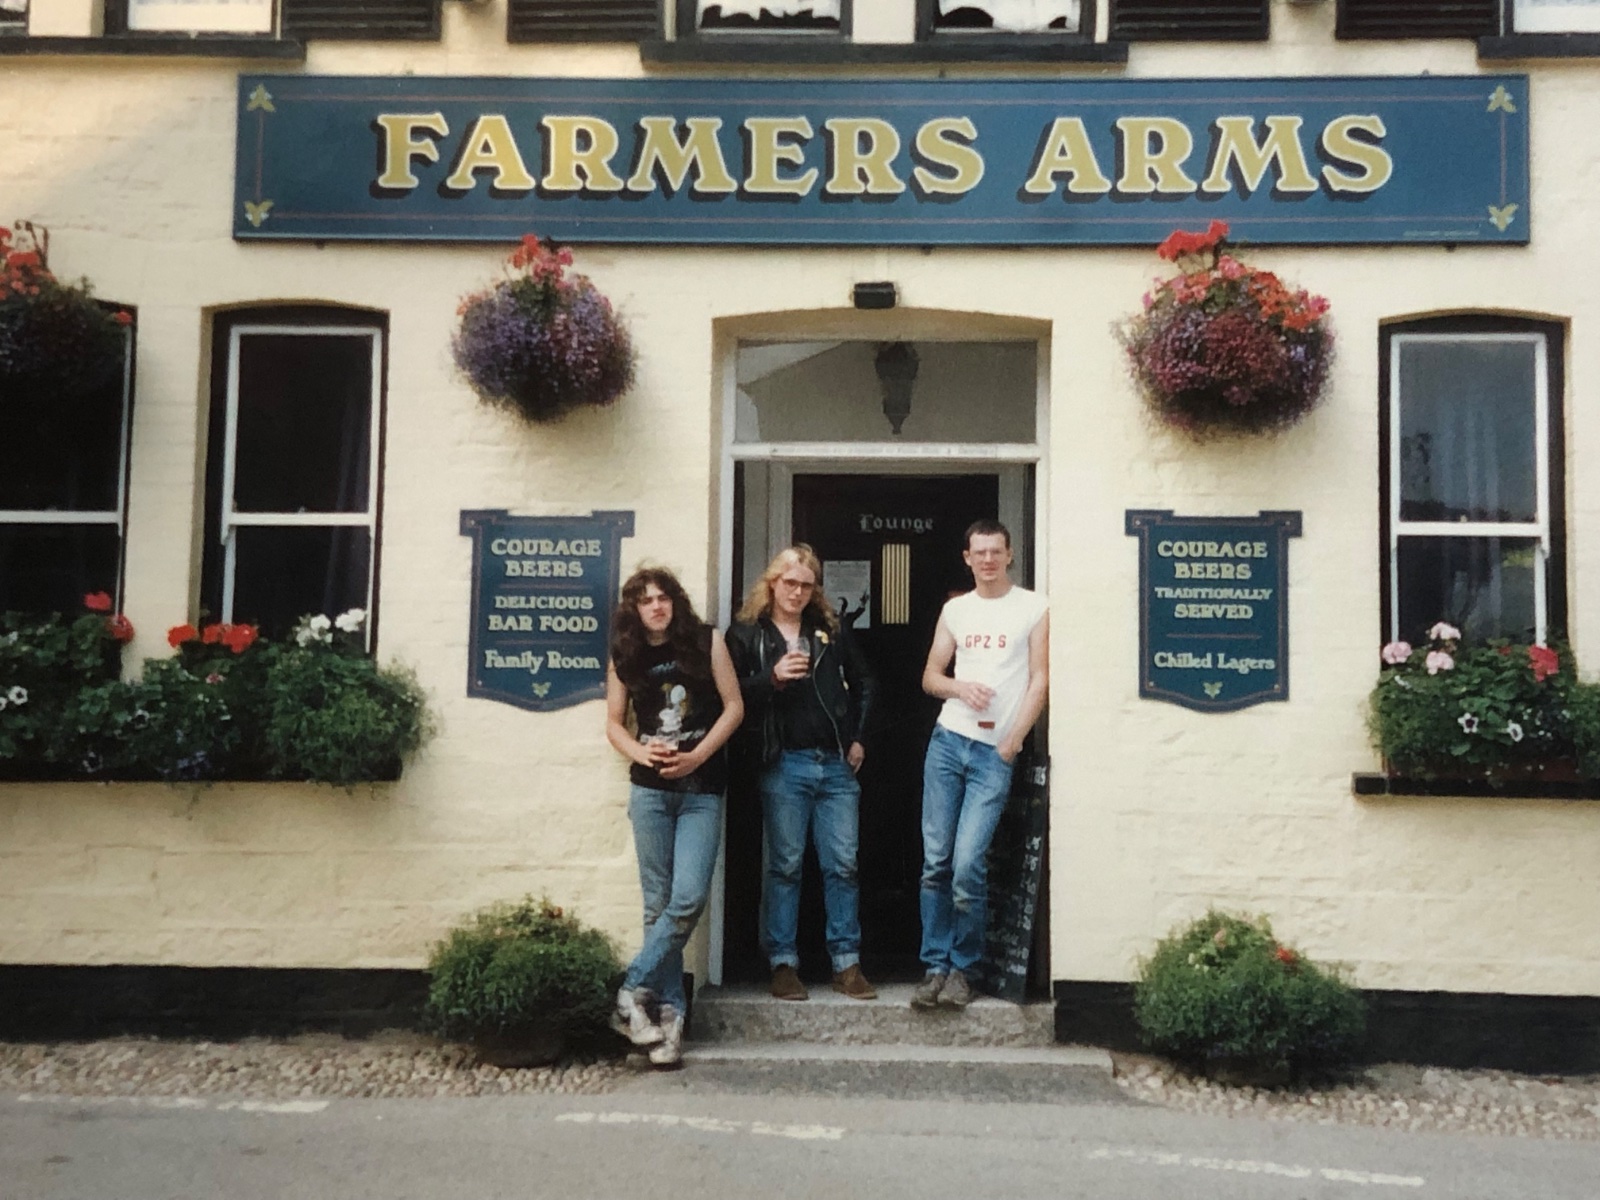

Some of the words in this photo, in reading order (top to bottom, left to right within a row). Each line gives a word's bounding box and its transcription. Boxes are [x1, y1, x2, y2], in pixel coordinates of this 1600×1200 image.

[373, 112, 985, 199] FARMERS
[1018, 114, 1393, 199] ARMS
[859, 513, 934, 534] Lounge
[491, 538, 602, 557] COURAGE
[1157, 540, 1268, 558] COURAGE
[505, 560, 583, 578] BEERS
[1174, 562, 1252, 580] BEERS
[494, 595, 594, 610] DELICIOUS
[1154, 586, 1273, 601] TRADITIONALLY
[1173, 603, 1253, 619] SERVED
[488, 614, 533, 631] BAR
[539, 615, 598, 633] FOOD
[485, 649, 544, 675] Family
[547, 651, 600, 669] Room
[1154, 651, 1212, 669] Chilled
[1217, 653, 1276, 674] Lagers
